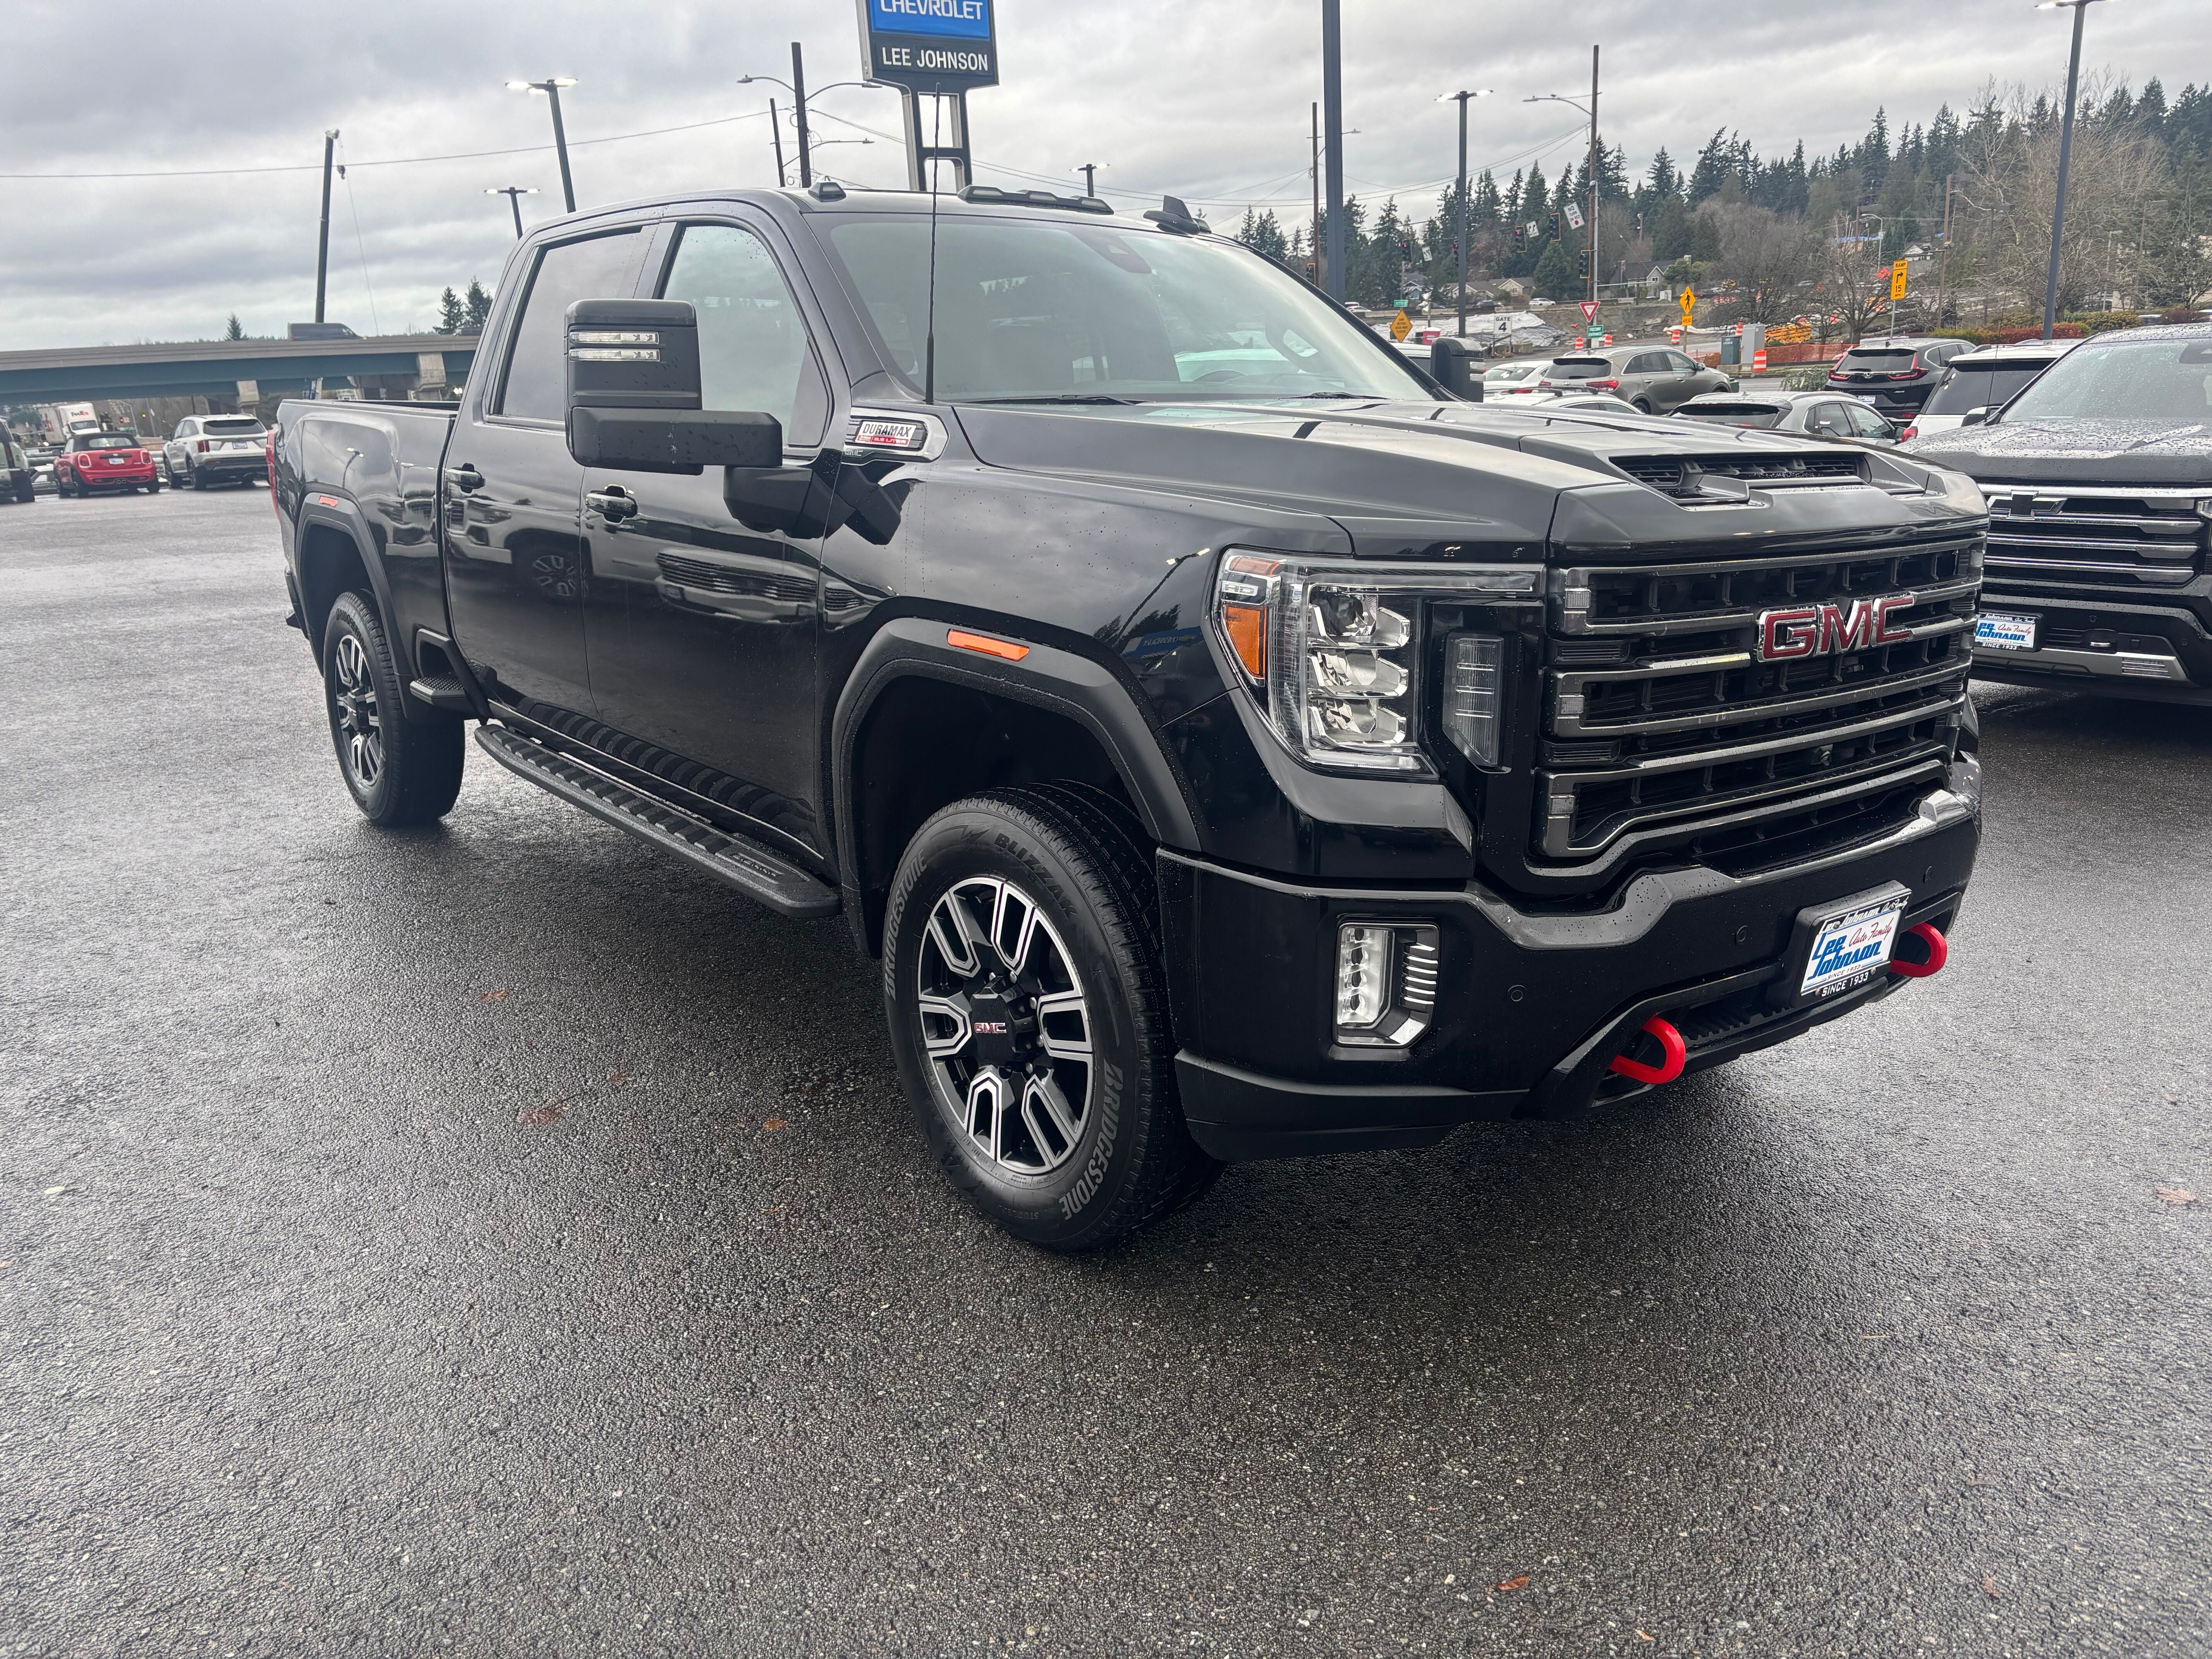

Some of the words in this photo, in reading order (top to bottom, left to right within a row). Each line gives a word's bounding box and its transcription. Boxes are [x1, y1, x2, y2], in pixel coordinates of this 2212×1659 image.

[881, 0, 983, 20] CHEVROLET
[882, 47, 911, 66] LEE
[917, 50, 988, 71] JOHNSON
[1499, 322, 1507, 332] 4
[862, 424, 912, 437] DURAMAX
[1758, 595, 1915, 663] GMC
[2013, 625, 2032, 636] Family
[994, 833, 1078, 920] BLIZZAK
[885, 848, 927, 1001] BRIDGESTONE
[1839, 908, 1881, 928] Johnson
[1812, 933, 1847, 961] Lee
[1849, 928, 1868, 947] Auto
[1868, 917, 1894, 941] Family
[1807, 941, 1882, 981] Johnson
[1827, 970, 1845, 980] SINCE
[1847, 964, 1862, 974] 1933
[1822, 980, 1847, 997] SINCE
[1850, 972, 1869, 987] 1933
[974, 1022, 1007, 1034] GMC
[1059, 1058, 1123, 1221] BRIDGESTONE
